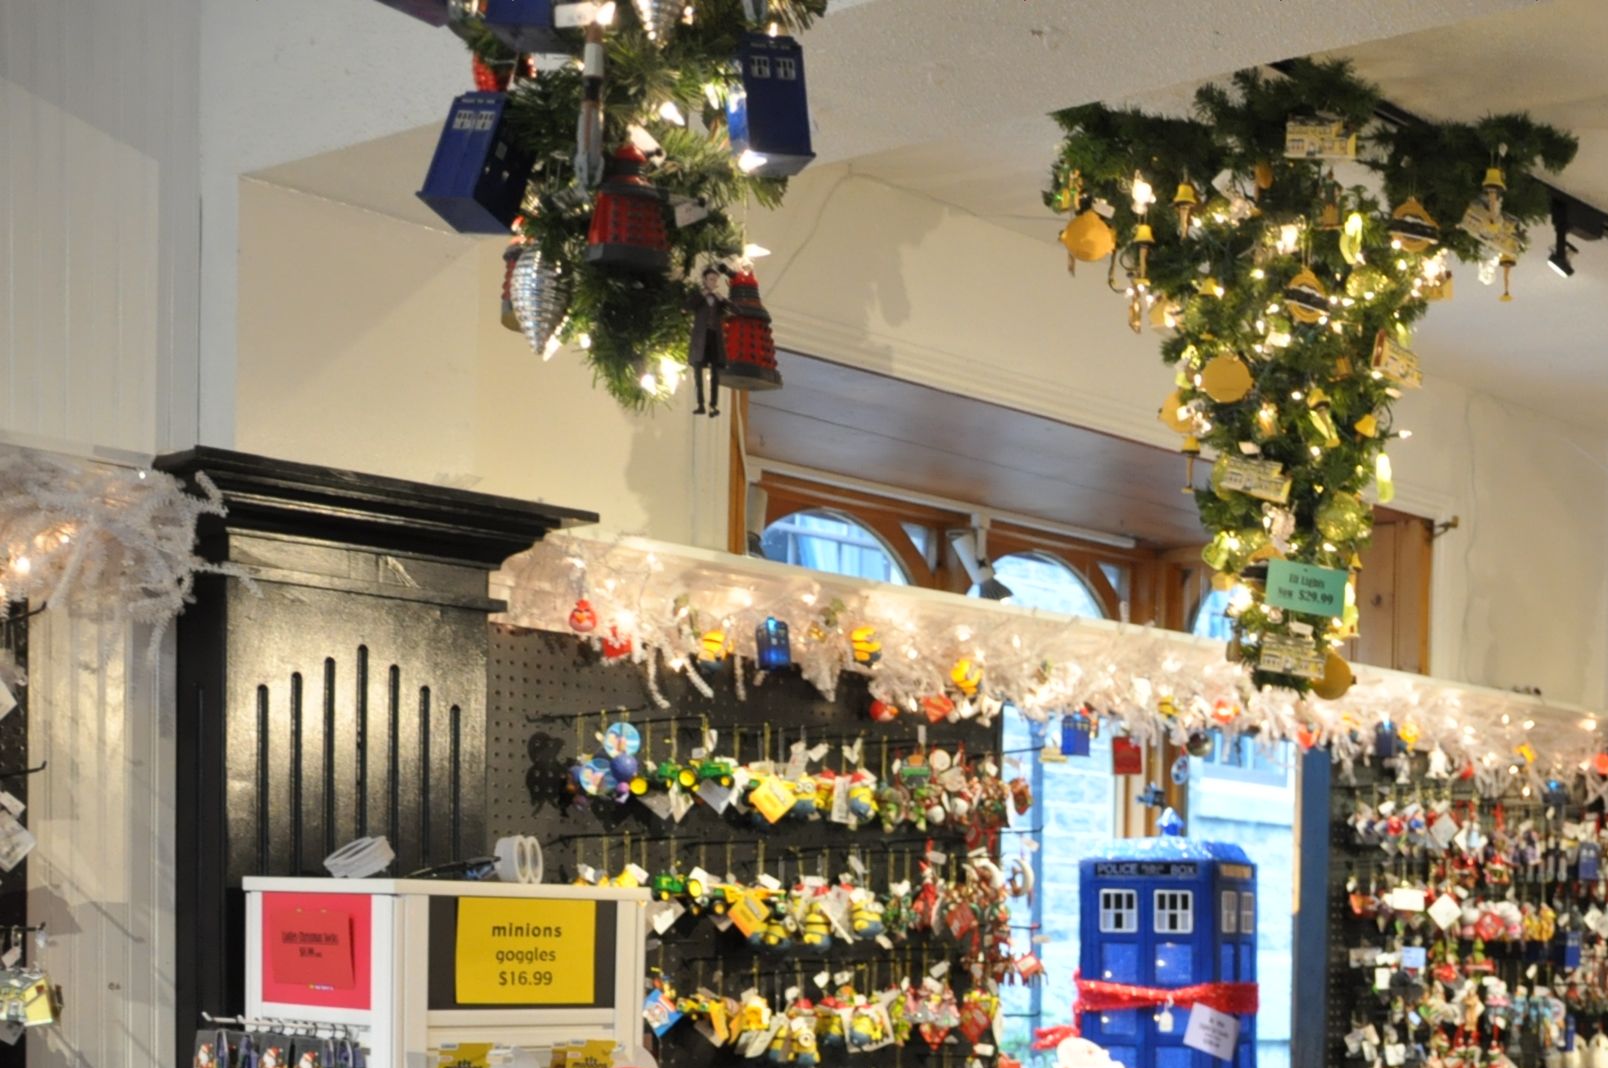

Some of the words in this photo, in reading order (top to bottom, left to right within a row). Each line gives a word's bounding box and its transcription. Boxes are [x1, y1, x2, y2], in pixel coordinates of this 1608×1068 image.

[1097, 863, 1138, 875] POLICE
[1169, 864, 1195, 875] BOX
[492, 922, 562, 938] minions
[495, 946, 556, 965] goggles
[498, 971, 553, 986] $16.99
